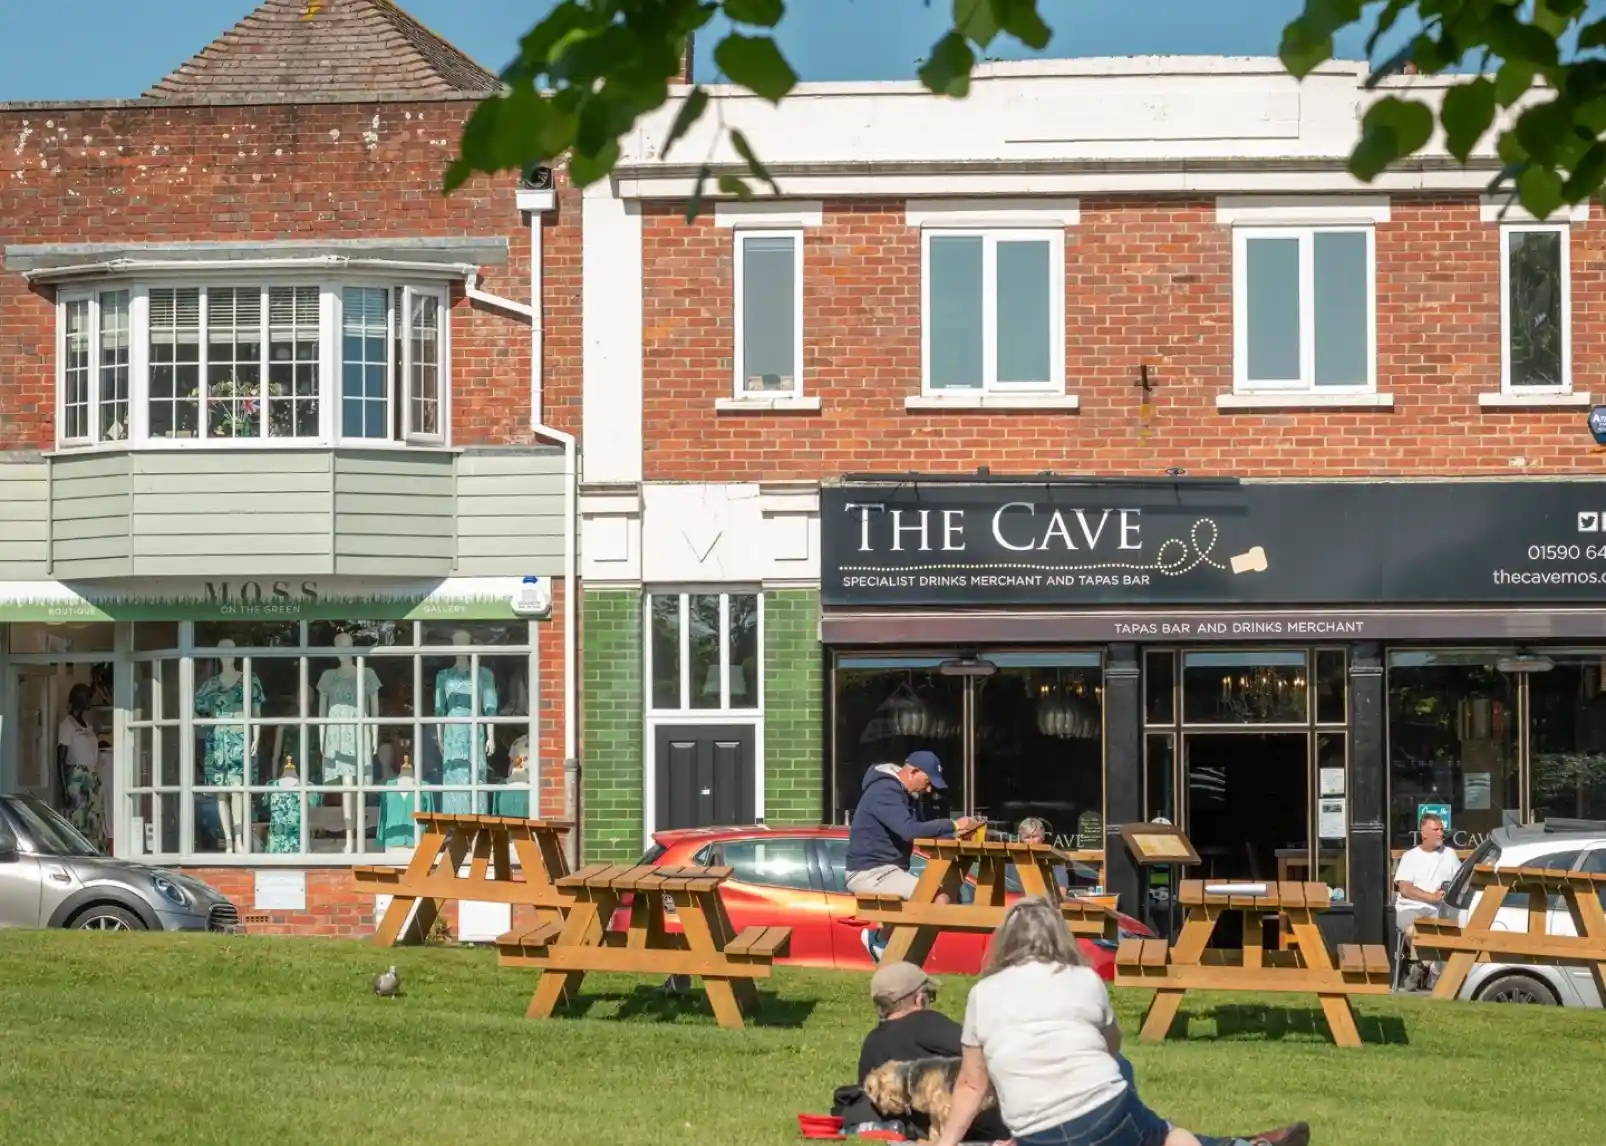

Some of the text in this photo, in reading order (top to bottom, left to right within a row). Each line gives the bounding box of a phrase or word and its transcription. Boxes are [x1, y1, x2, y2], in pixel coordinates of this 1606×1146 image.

[844, 501, 1144, 552] THE CAVE
[1528, 545, 1580, 560] 01590
[843, 575, 1150, 588] SPECIALIST DRINKS MERCHANT AND TAPAS BAR
[204, 580, 318, 603] MOSS
[48, 607, 96, 616] BOUTIQUE
[220, 604, 301, 615] ON THE GREEN
[423, 605, 466, 614] GALLERY
[1114, 621, 1364, 634] TAPAS BAR AND DRINKS MERCHANT
